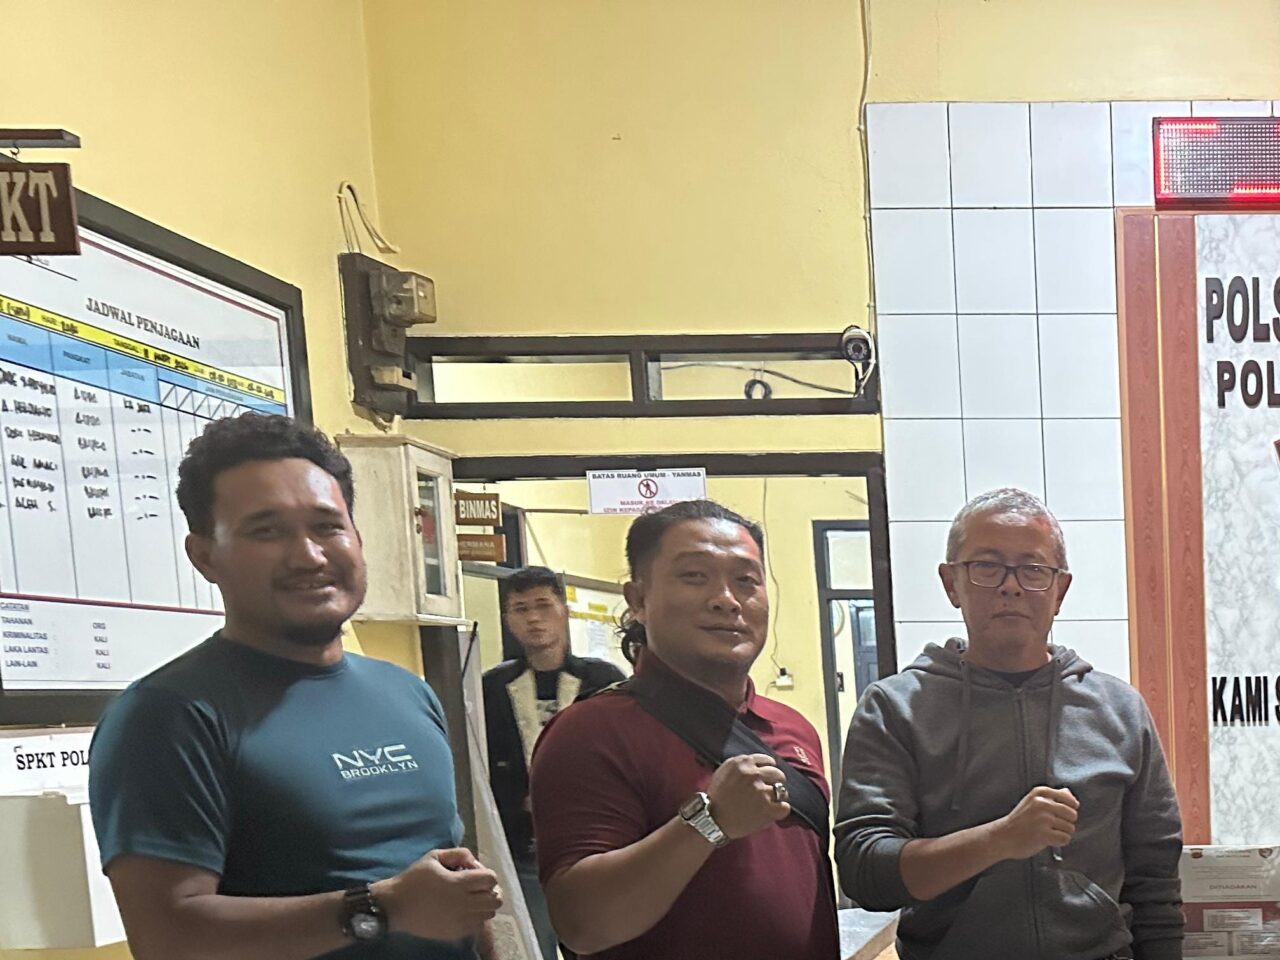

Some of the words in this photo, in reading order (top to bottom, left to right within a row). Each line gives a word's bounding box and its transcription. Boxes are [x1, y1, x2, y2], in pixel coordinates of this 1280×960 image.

[86, 298, 135, 326] JADWAL
[135, 315, 200, 349] PENJAGAAN
[459, 500, 498, 519] BINMAS
[1212, 676, 1269, 722] KAMI
[16, 752, 56, 770] SPKT
[332, 744, 412, 769] NYC
[341, 761, 418, 779] BROOKLYN
